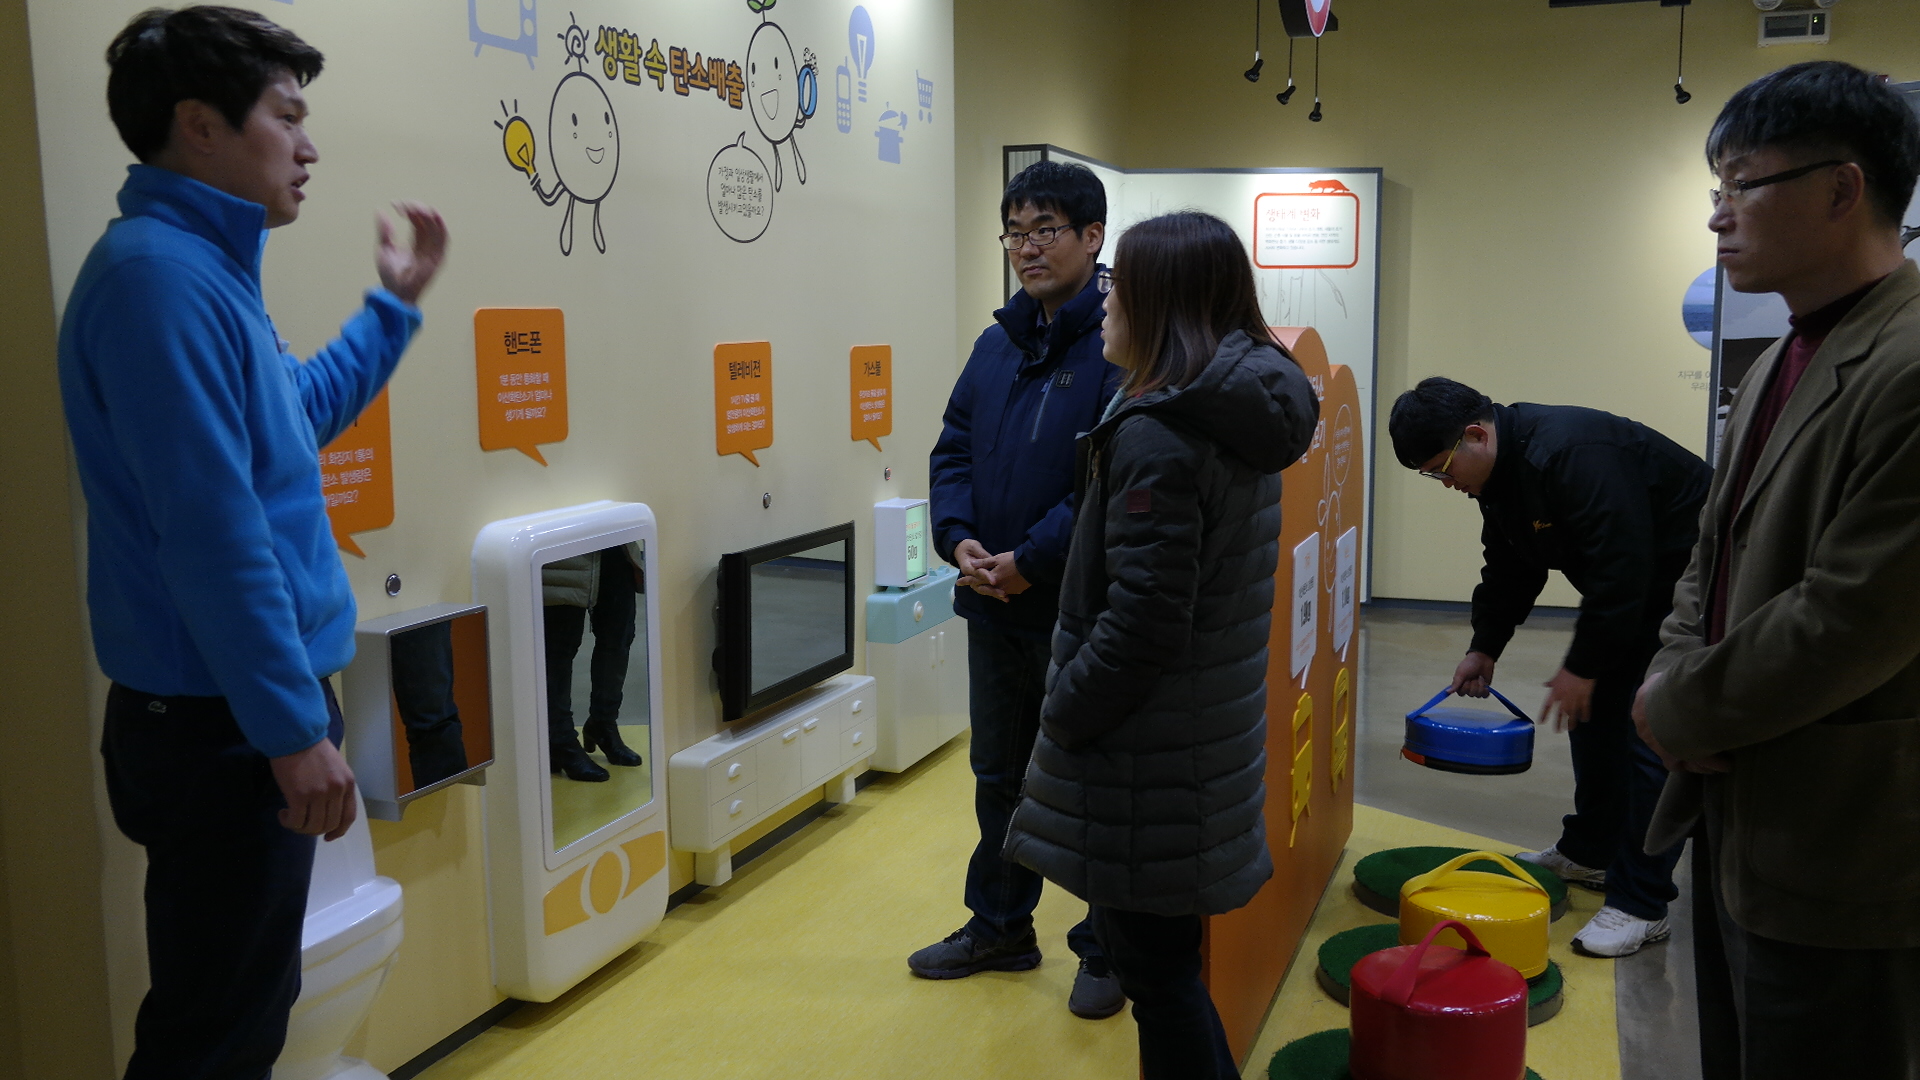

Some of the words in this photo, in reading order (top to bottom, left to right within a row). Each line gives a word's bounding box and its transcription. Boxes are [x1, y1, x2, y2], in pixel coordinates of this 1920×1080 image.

[594, 24, 643, 86] 생활
[643, 38, 668, 92] 속
[669, 45, 745, 110] 탄소배출
[720, 182, 736, 198] 얼마나
[504, 331, 542, 355] 핸드폰
[327, 450, 353, 465] 화장지
[339, 467, 372, 486] 발생량은
[908, 545, 917, 561] 50g
